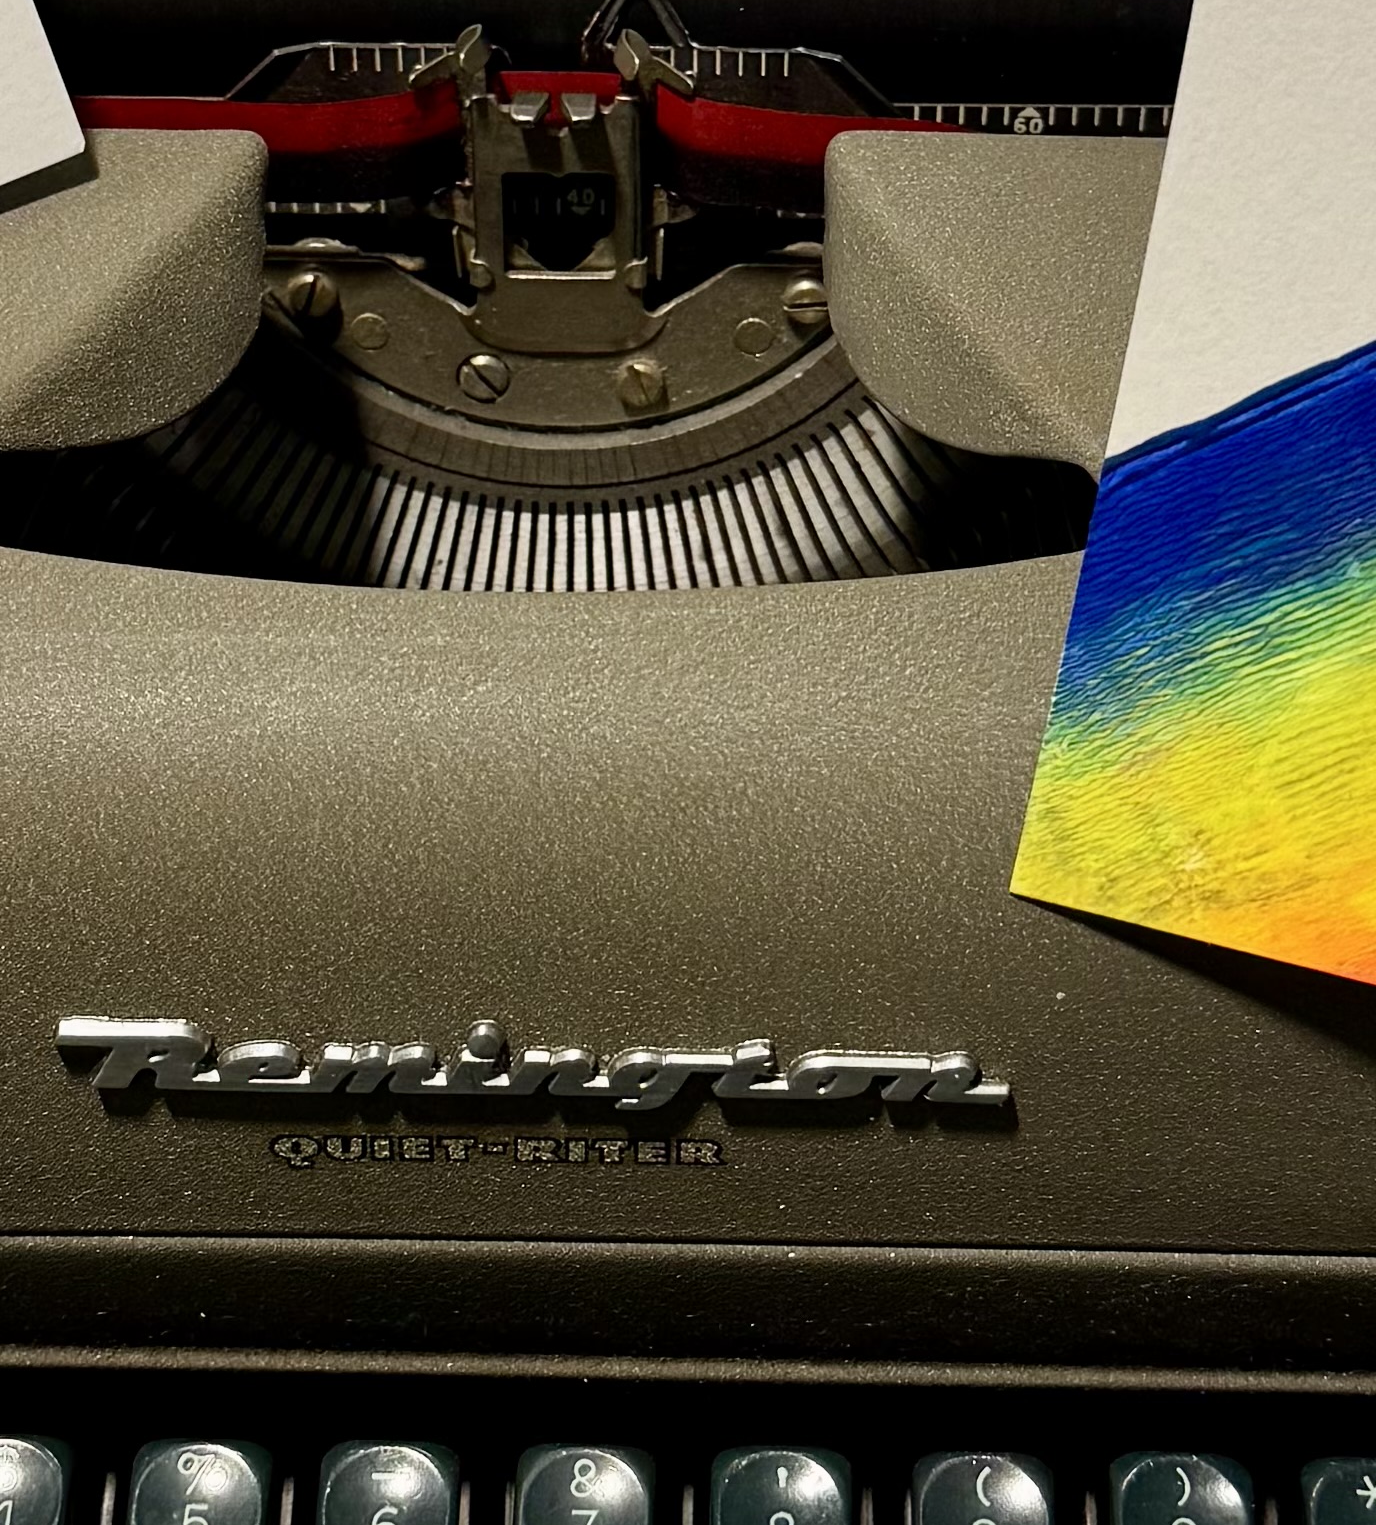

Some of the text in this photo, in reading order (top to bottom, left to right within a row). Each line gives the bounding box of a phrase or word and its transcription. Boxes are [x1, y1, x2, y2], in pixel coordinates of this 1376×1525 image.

[1014, 118, 1043, 135] 60
[567, 187, 595, 205] 40
[53, 1014, 1016, 1113] Remington
[270, 1134, 726, 1169] QUIET-RITER
[569, 1458, 601, 1498] &
